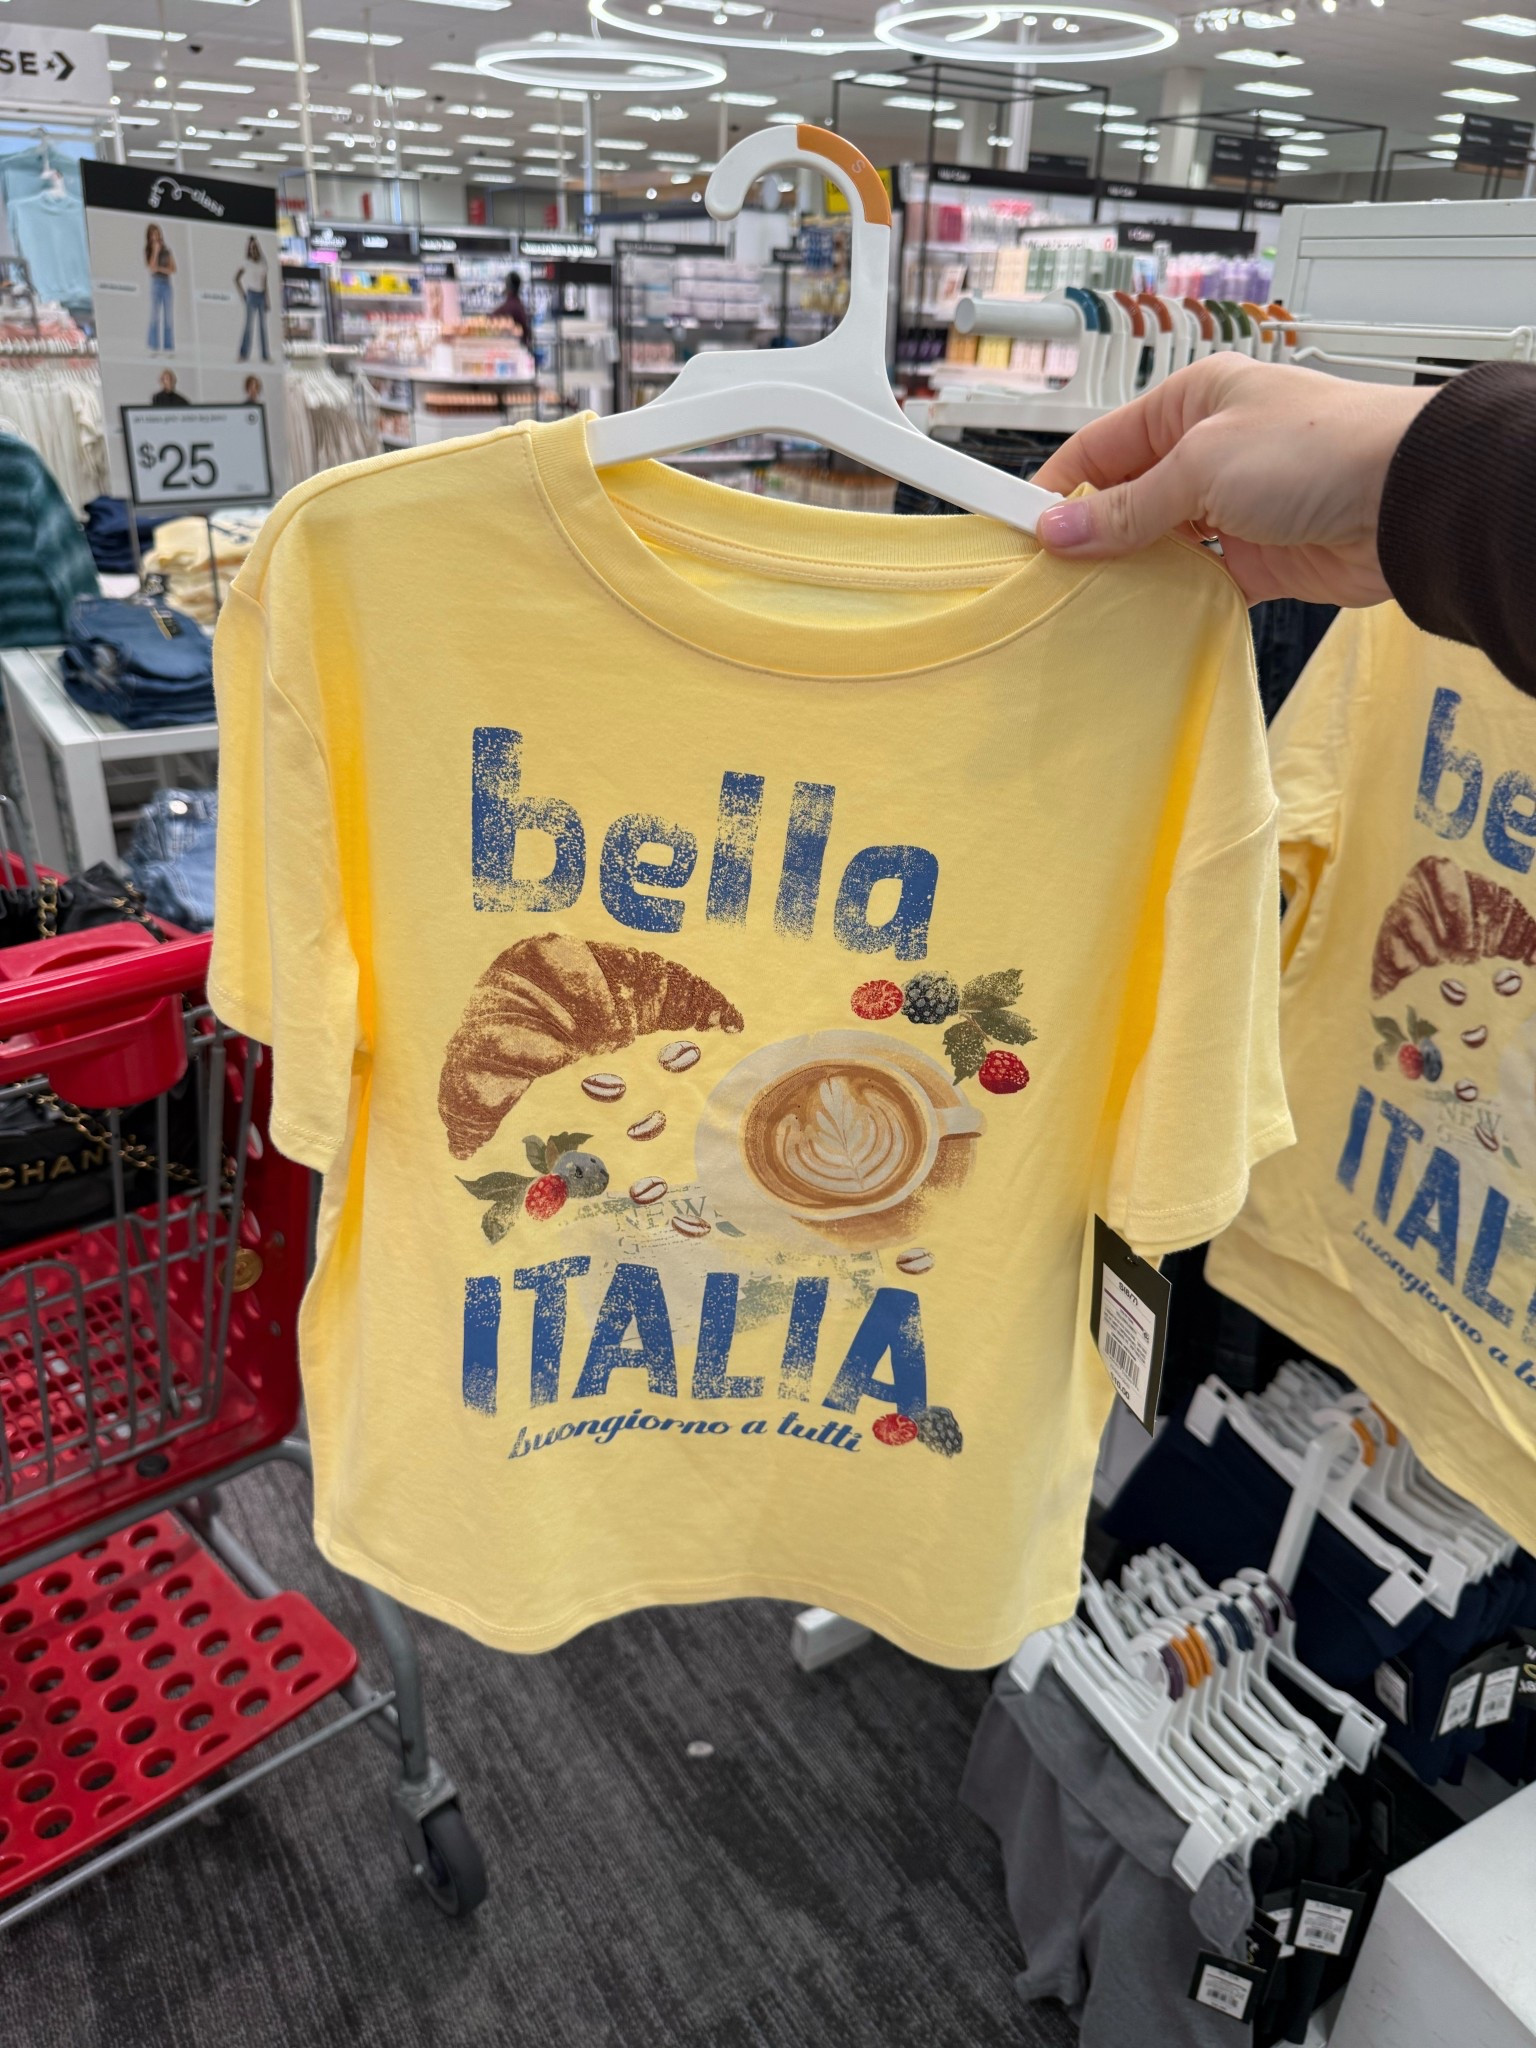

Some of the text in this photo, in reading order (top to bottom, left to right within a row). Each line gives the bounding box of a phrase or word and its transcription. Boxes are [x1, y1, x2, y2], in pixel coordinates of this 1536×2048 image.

[0, 49, 38, 76] SE
[851, 160, 866, 173] S
[138, 443, 218, 490] $25
[472, 727, 938, 961] bella
[1352, 1220, 1483, 1345] buongiorno
[1488, 1345, 1508, 1369] a
[462, 1256, 927, 1418] ITALIA
[508, 1408, 862, 1460] buongiorno a tutti
